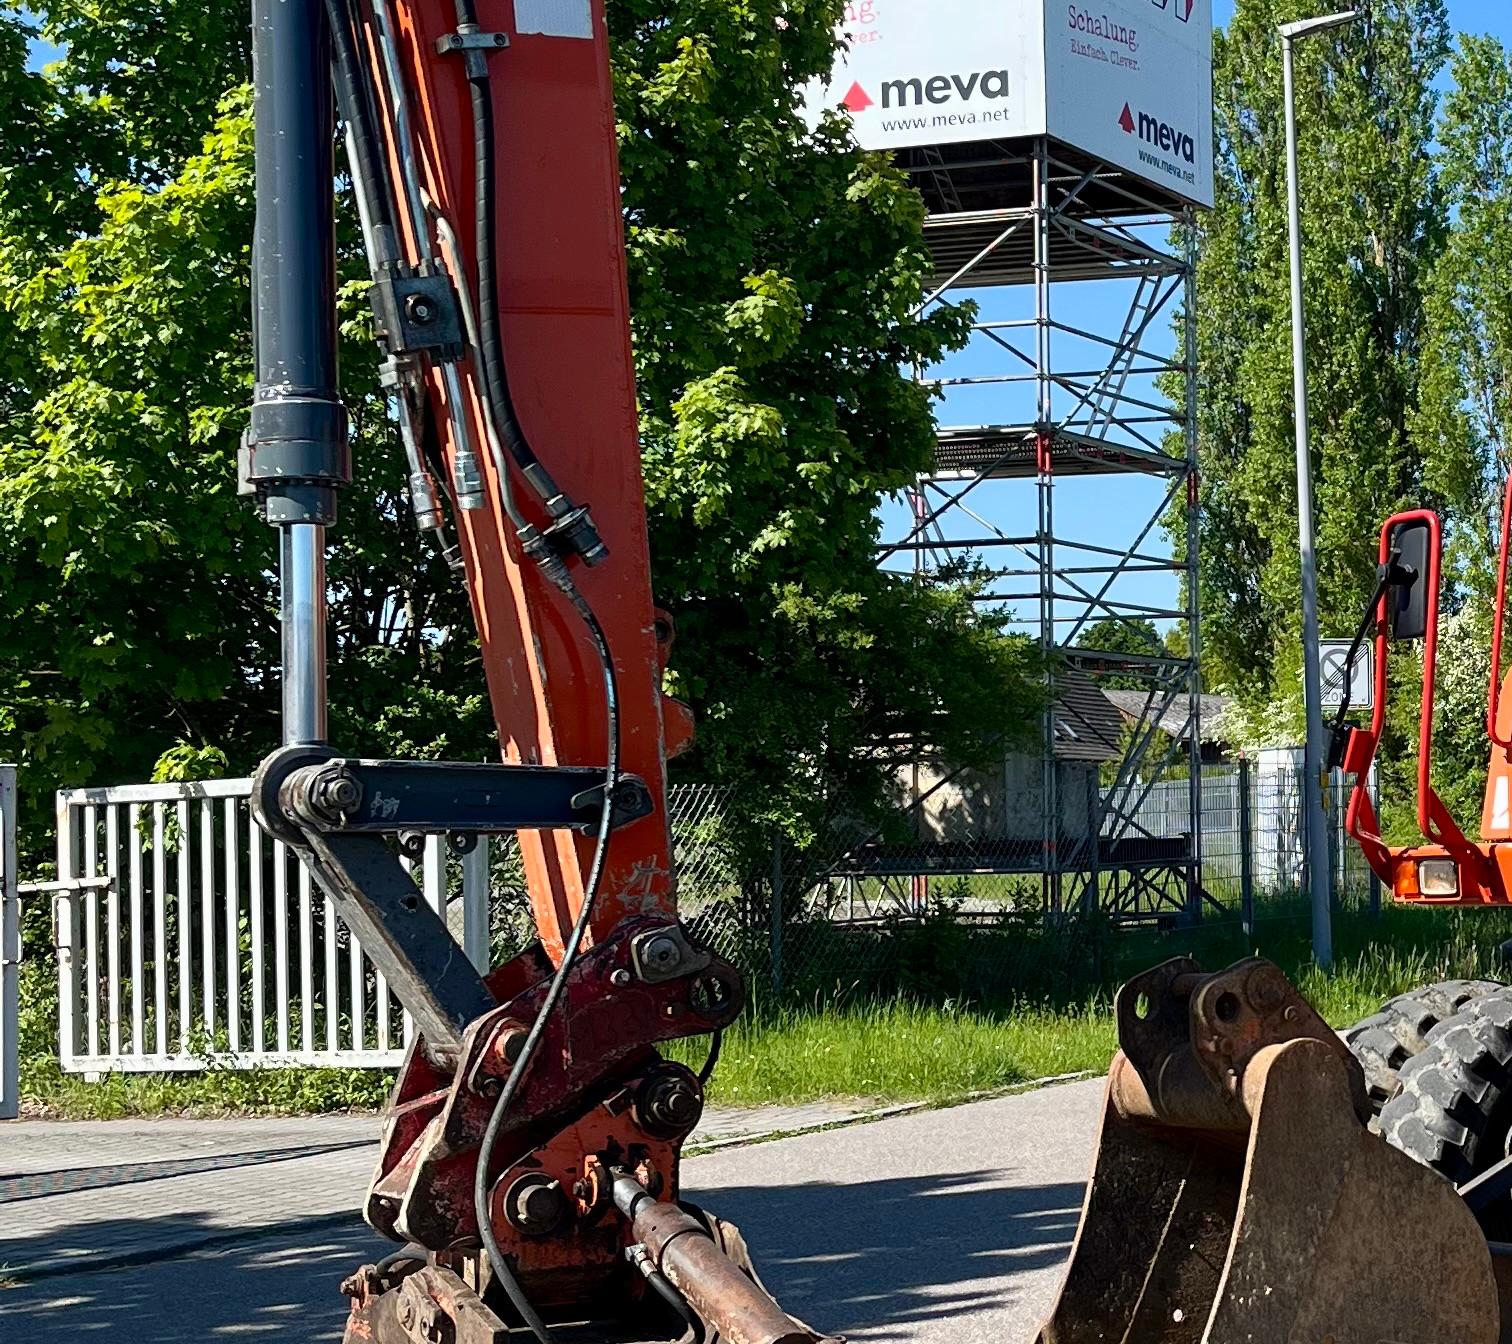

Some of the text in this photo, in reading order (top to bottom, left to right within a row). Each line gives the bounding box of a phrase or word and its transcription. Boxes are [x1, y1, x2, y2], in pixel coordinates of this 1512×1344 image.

[881, 69, 1009, 109] meva
[882, 107, 1009, 132] www.meva.net
[1138, 111, 1195, 164] meva
[1138, 148, 1195, 185] www.meva.net
